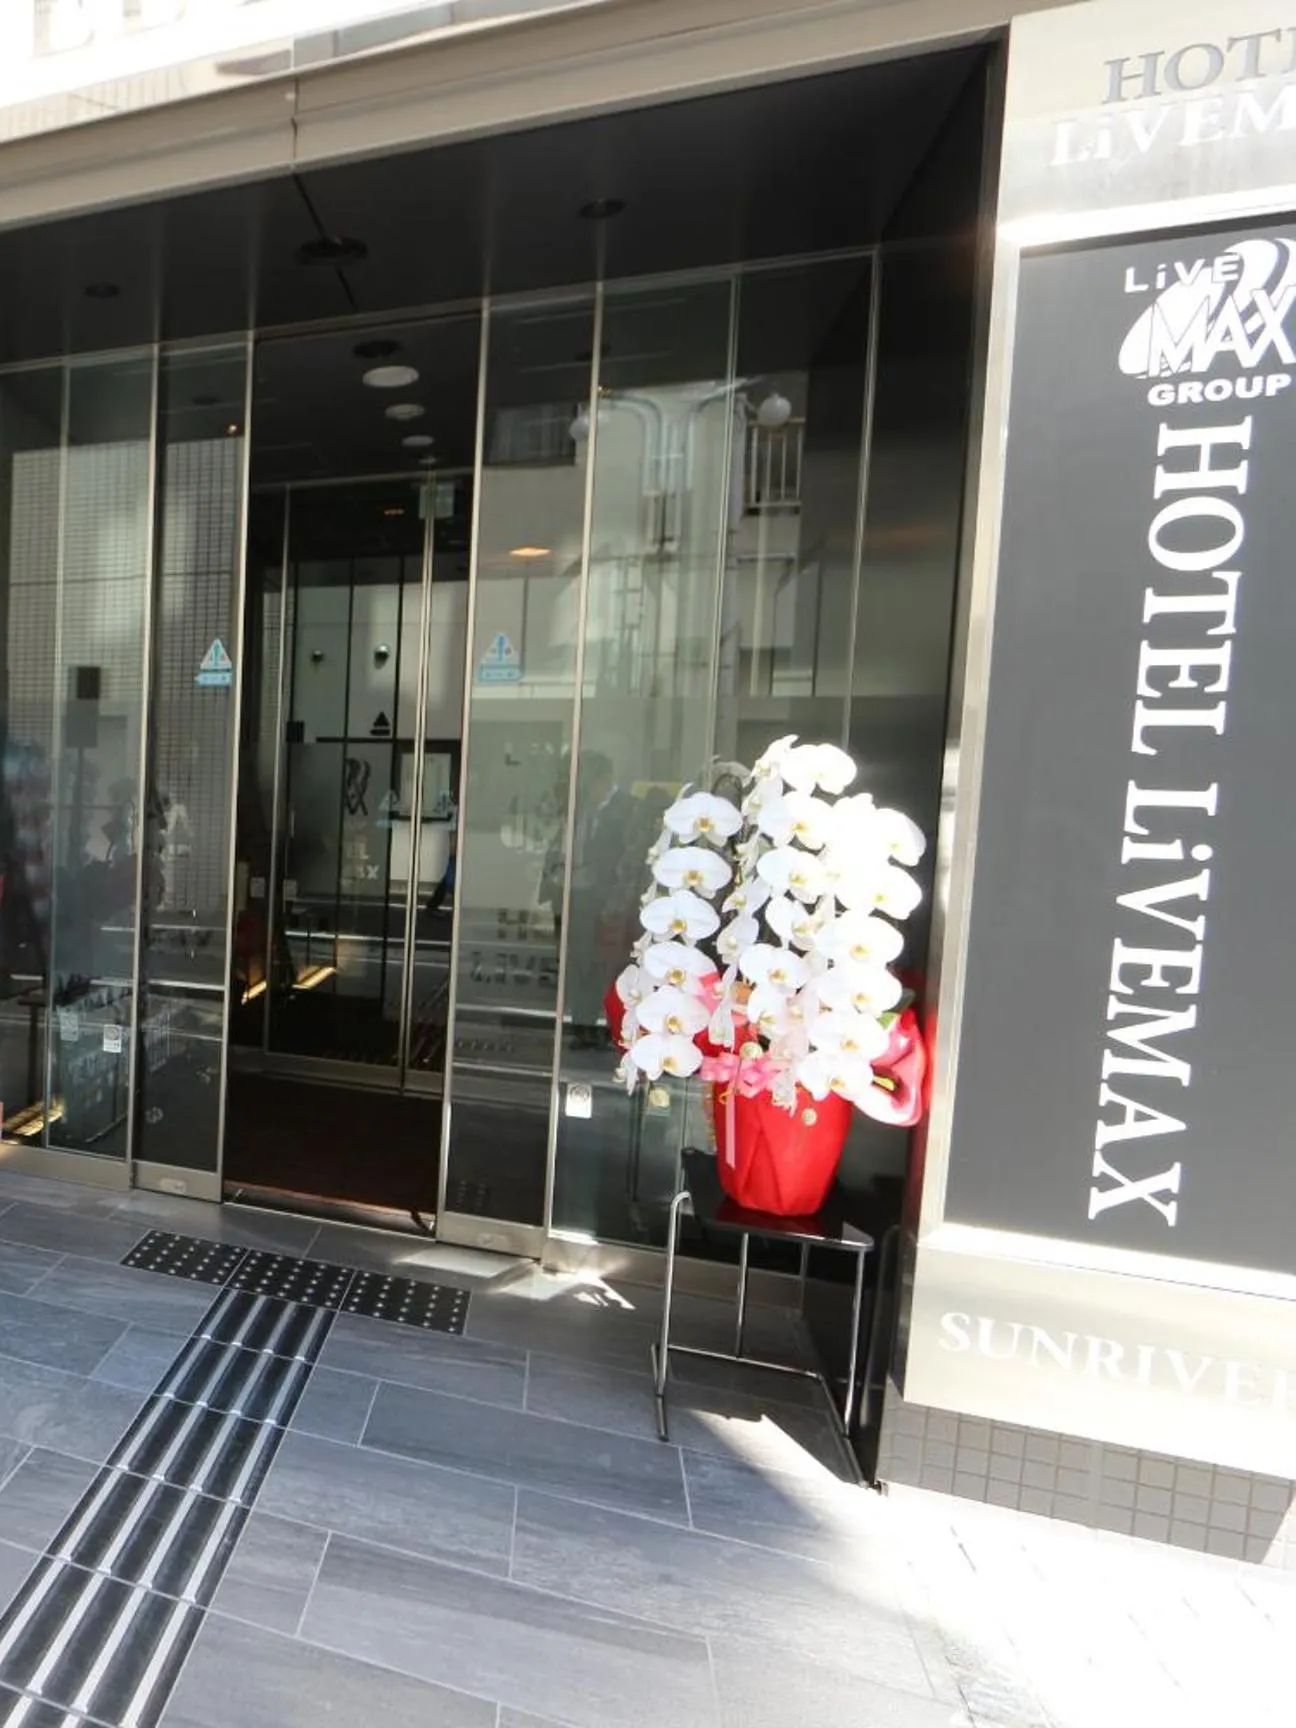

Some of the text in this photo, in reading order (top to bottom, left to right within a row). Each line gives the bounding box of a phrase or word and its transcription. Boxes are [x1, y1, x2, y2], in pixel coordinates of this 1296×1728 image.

[1148, 285, 1296, 377] MAX
[1147, 373, 1292, 406] GROUP
[1088, 415, 1253, 1227] HOTEL LiVEMAX
